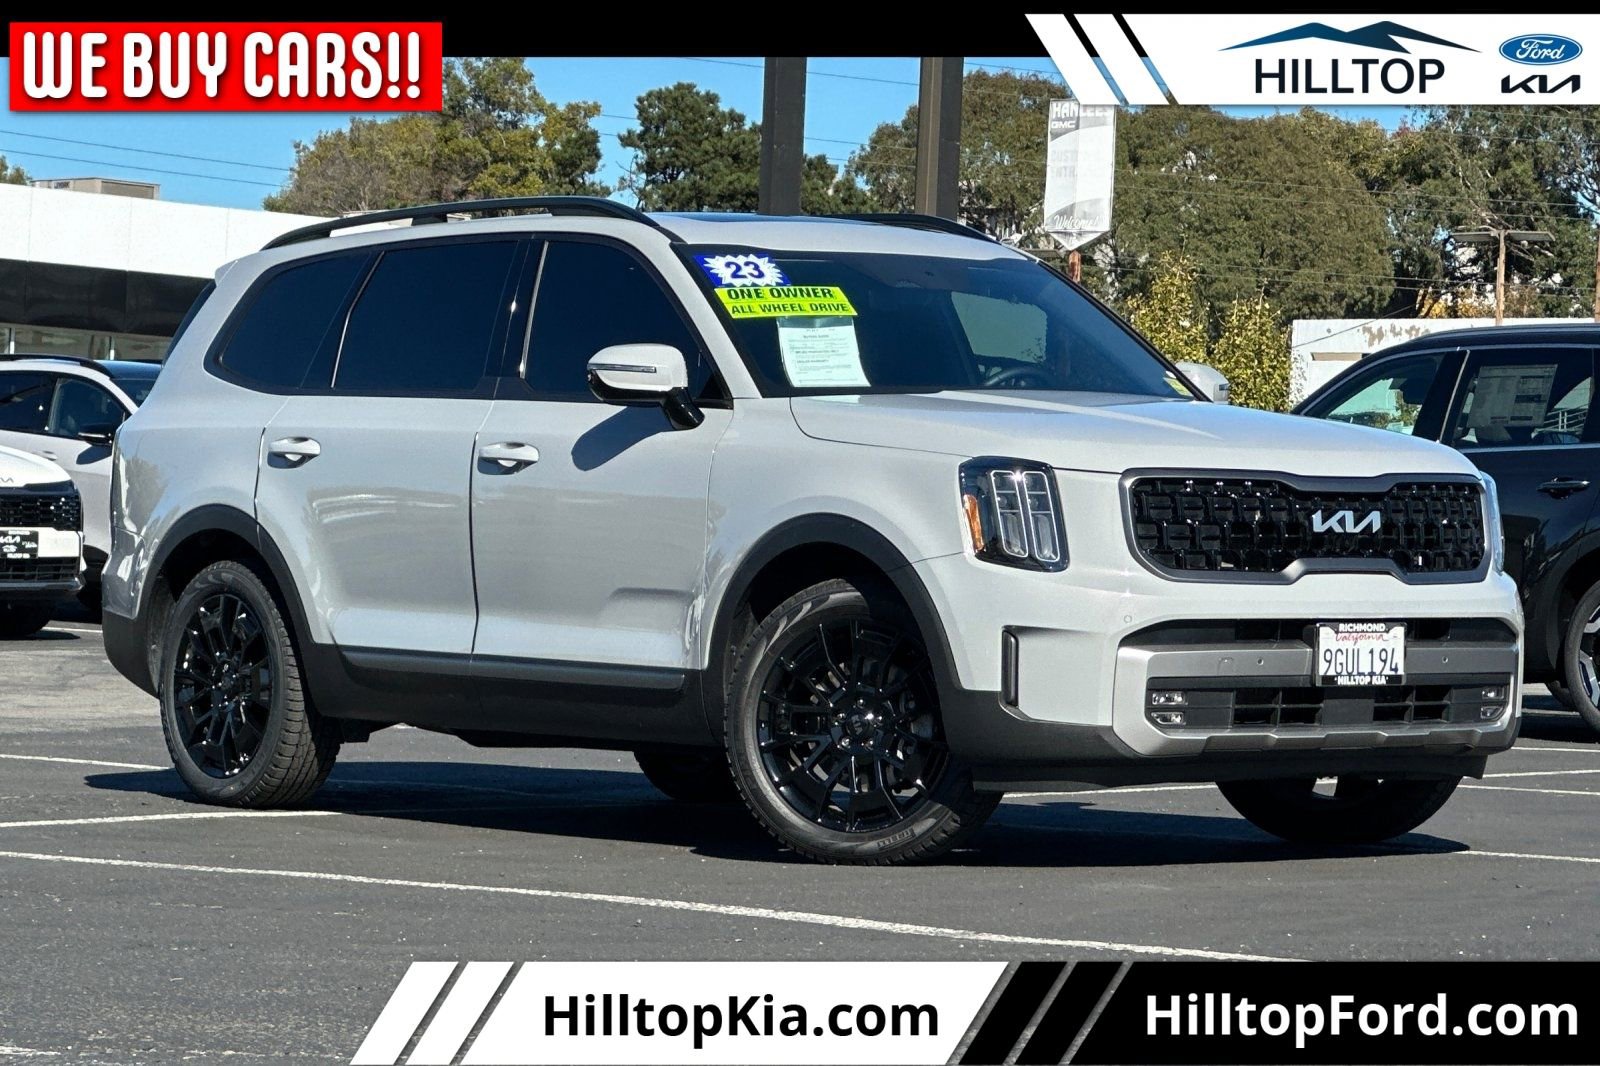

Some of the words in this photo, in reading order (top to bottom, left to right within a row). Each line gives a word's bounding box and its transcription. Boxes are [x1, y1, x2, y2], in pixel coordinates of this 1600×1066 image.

[724, 260, 765, 279] 23
[726, 287, 765, 300] ONE
[769, 286, 834, 299] OWNER
[731, 303, 756, 315] ALL
[759, 302, 807, 314] WHEEL
[809, 302, 850, 313] DRIVE
[1312, 509, 1381, 533] KIA
[1338, 622, 1387, 632] RICHMOND
[1323, 647, 1400, 676] 9GUL194
[1337, 675, 1371, 686] HILLTOP
[1371, 675, 1387, 686] KIA
